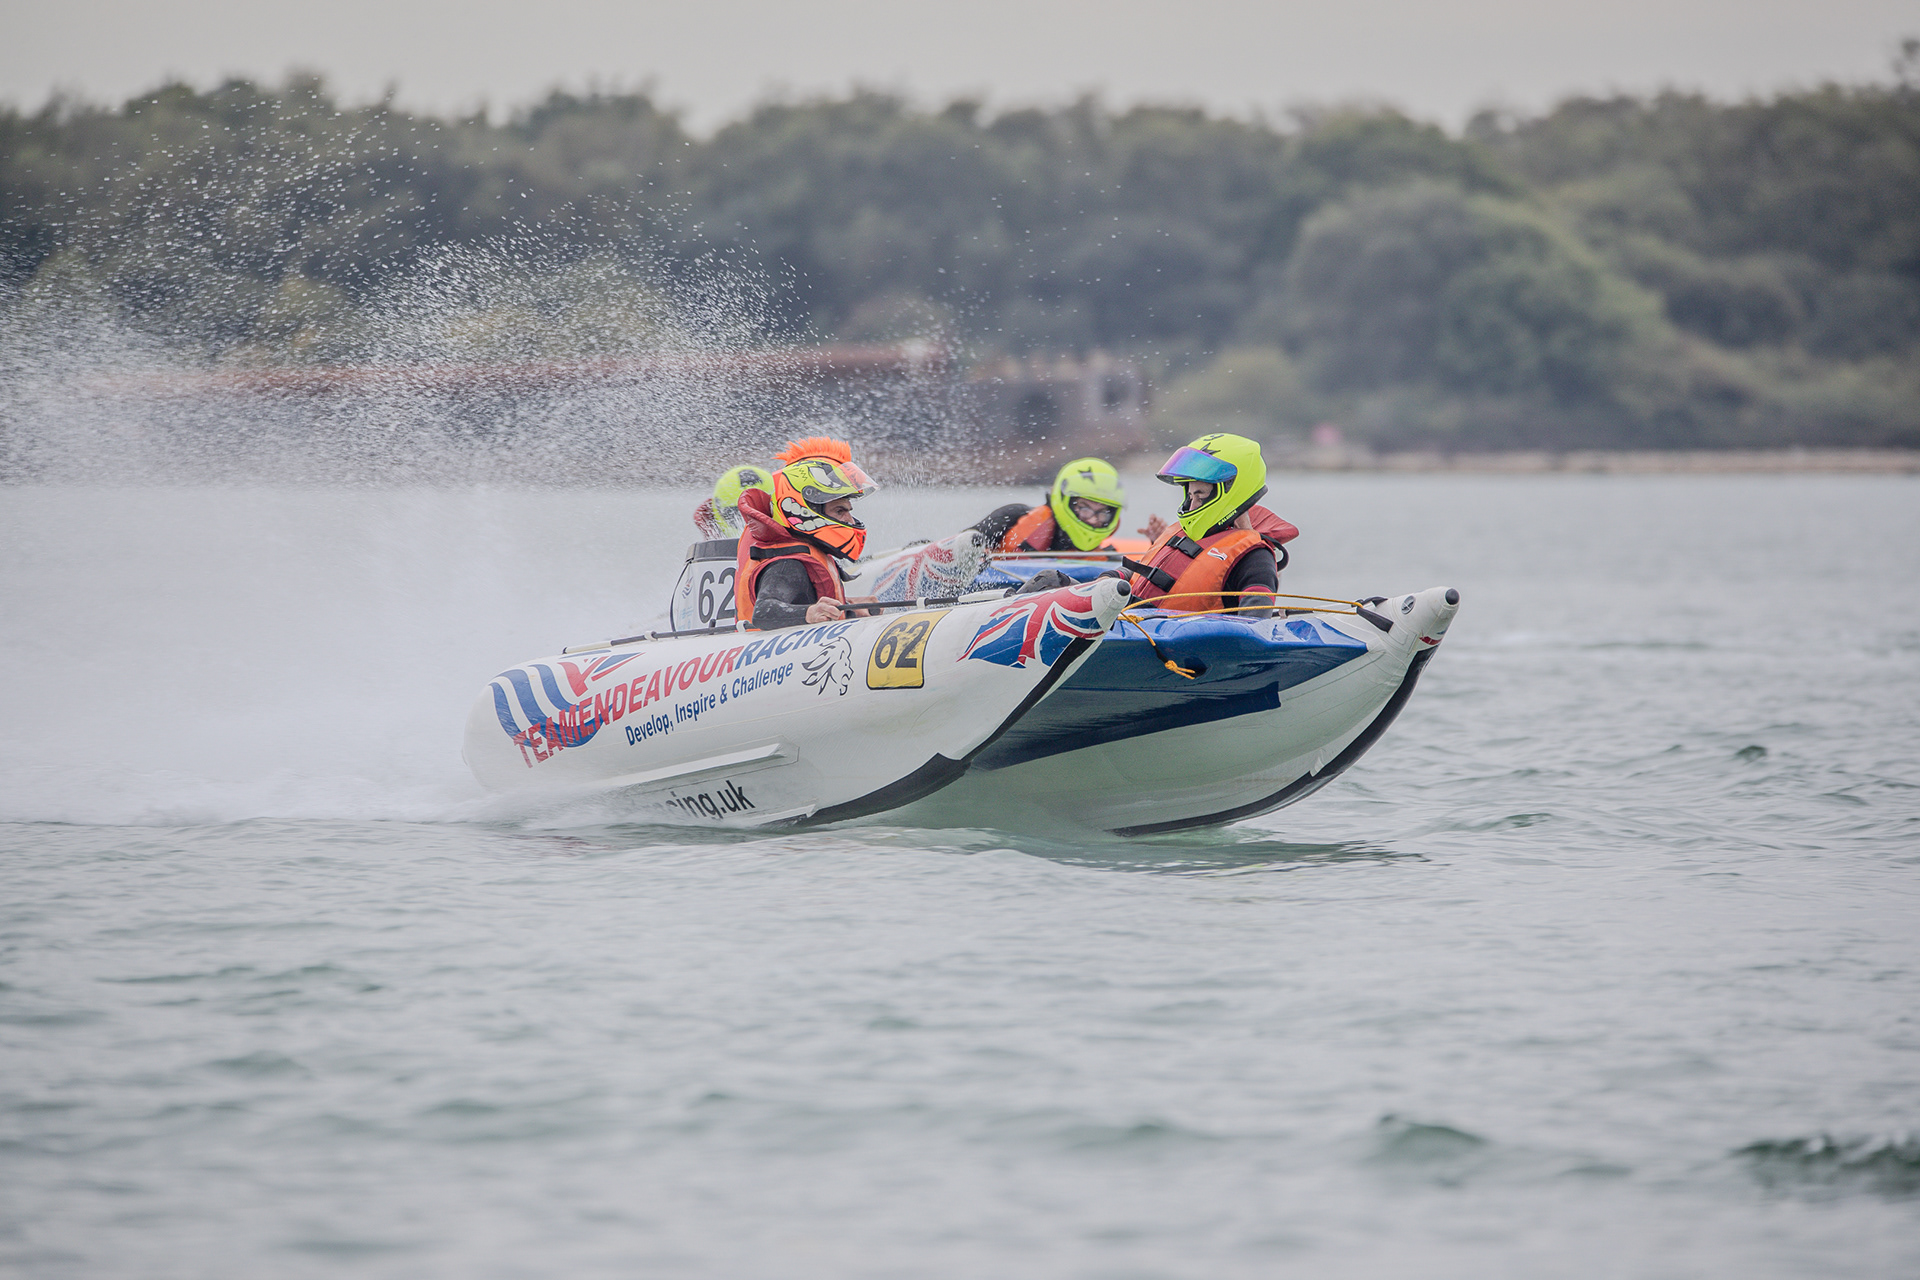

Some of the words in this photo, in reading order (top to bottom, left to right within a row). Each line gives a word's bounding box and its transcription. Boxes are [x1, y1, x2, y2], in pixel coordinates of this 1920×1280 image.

[699, 567, 737, 624] 62
[874, 620, 930, 669] 62
[625, 714, 675, 746] Develop,
[675, 693, 716, 724] Inspire
[719, 683, 728, 705] &
[732, 662, 794, 699] Challenge
